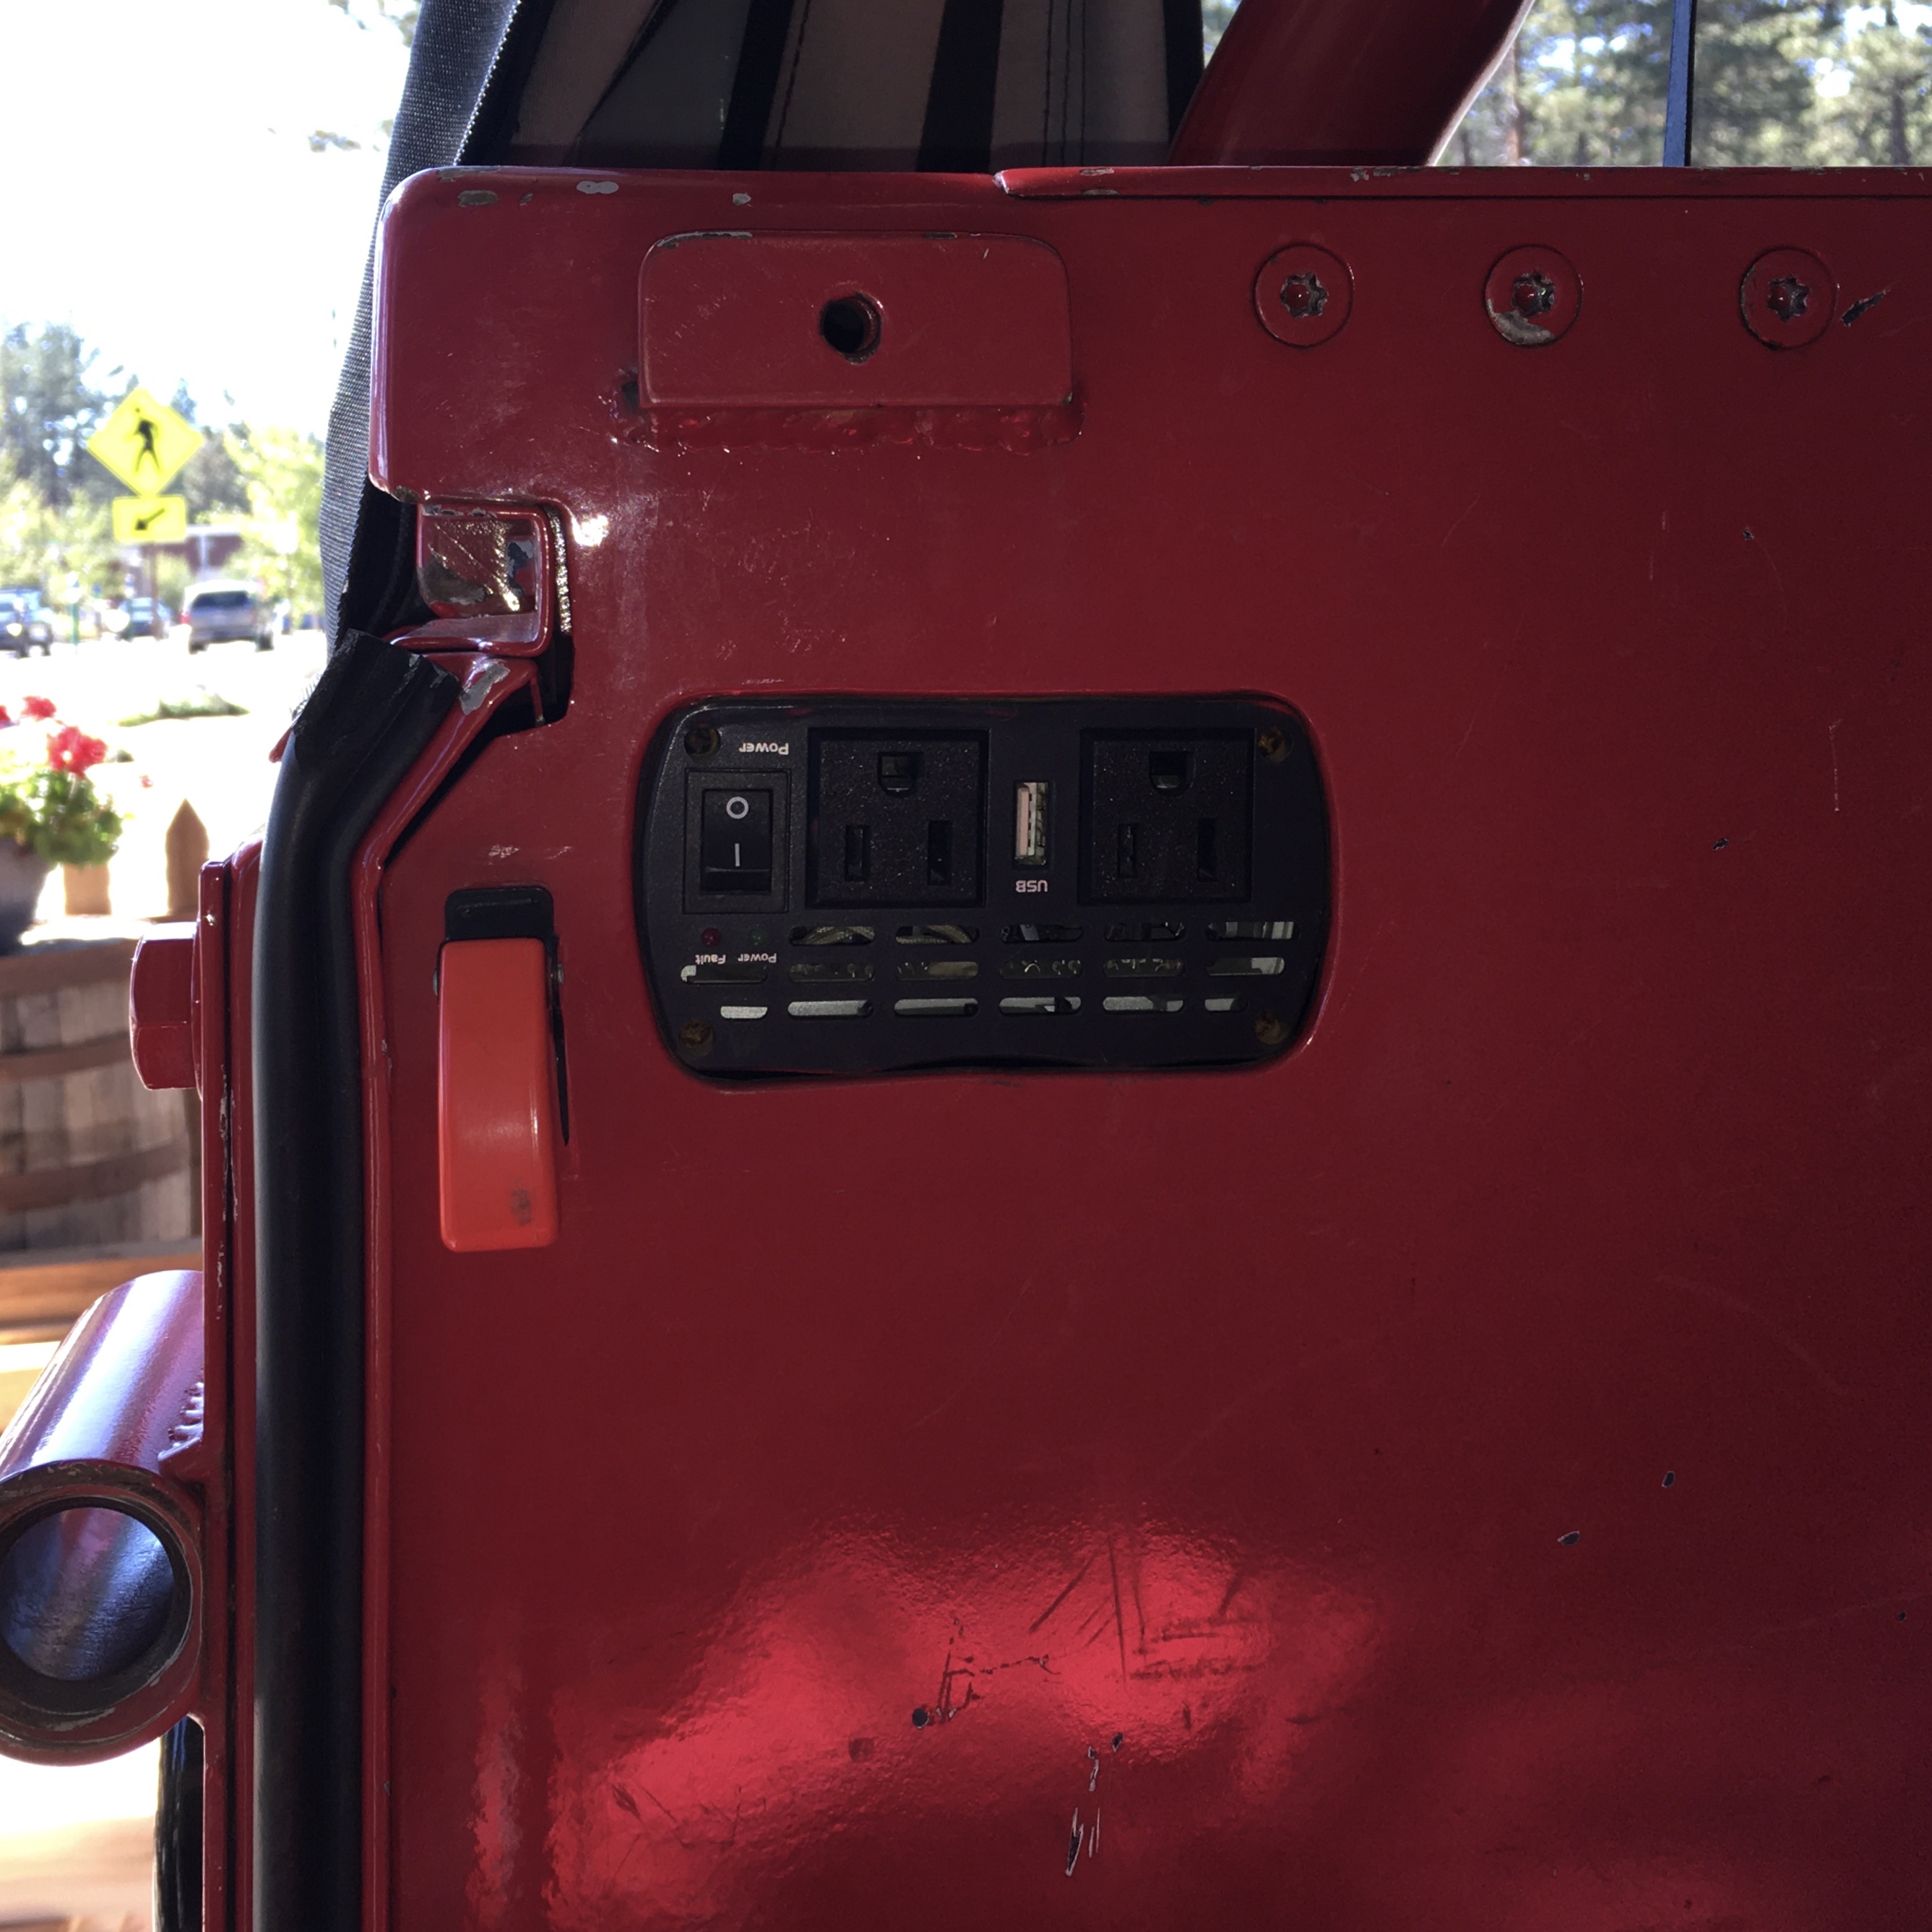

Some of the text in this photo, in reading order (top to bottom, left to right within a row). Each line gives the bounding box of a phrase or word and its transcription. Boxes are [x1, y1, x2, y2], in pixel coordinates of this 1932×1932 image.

[738, 742, 789, 756] Power
[1015, 879, 1048, 893] USB
[695, 954, 726, 965] Fault
[737, 953, 777, 964] Power
